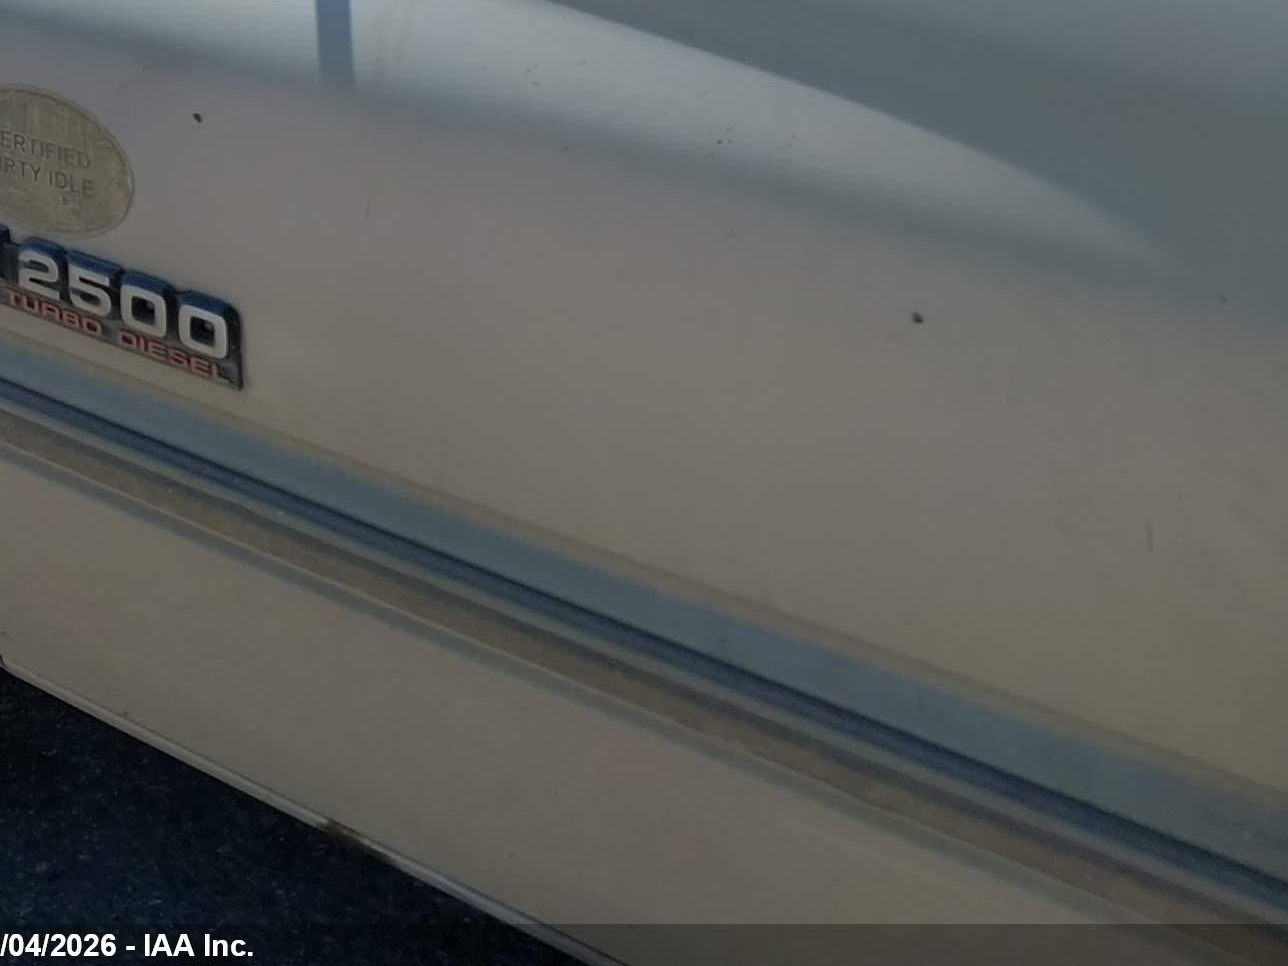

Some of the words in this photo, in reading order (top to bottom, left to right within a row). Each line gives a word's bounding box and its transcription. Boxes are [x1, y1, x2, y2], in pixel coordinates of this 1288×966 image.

[49, 170, 95, 198] IDLE
[7, 292, 103, 336] TURBO
[118, 329, 232, 382] DIESEL
[18, 236, 240, 360] 2500
